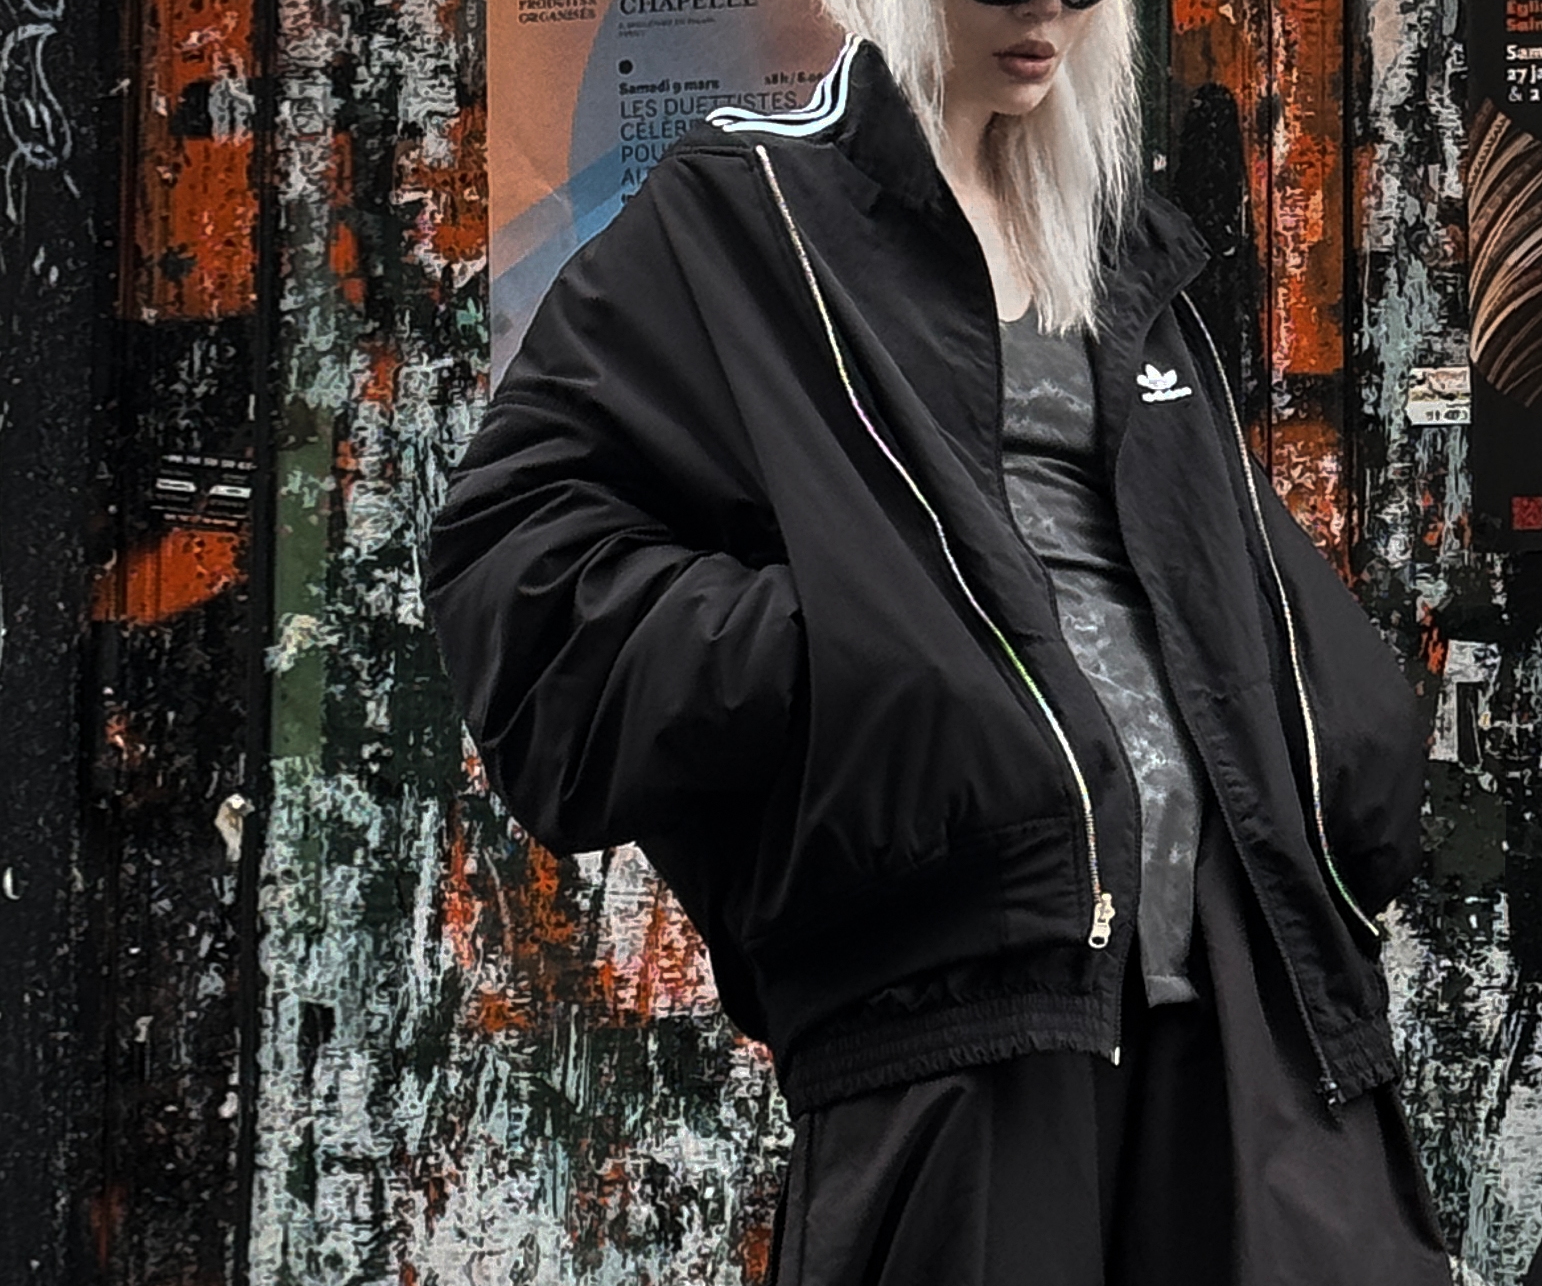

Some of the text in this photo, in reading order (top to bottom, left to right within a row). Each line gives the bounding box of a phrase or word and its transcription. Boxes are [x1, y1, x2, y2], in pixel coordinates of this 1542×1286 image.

[1506, 67, 1527, 85] 27
[619, 78, 720, 96] Samedi 9 mars
[1508, 86, 1523, 103] &
[1529, 89, 1540, 102] 2
[619, 90, 799, 120] LES DUETTISTES
